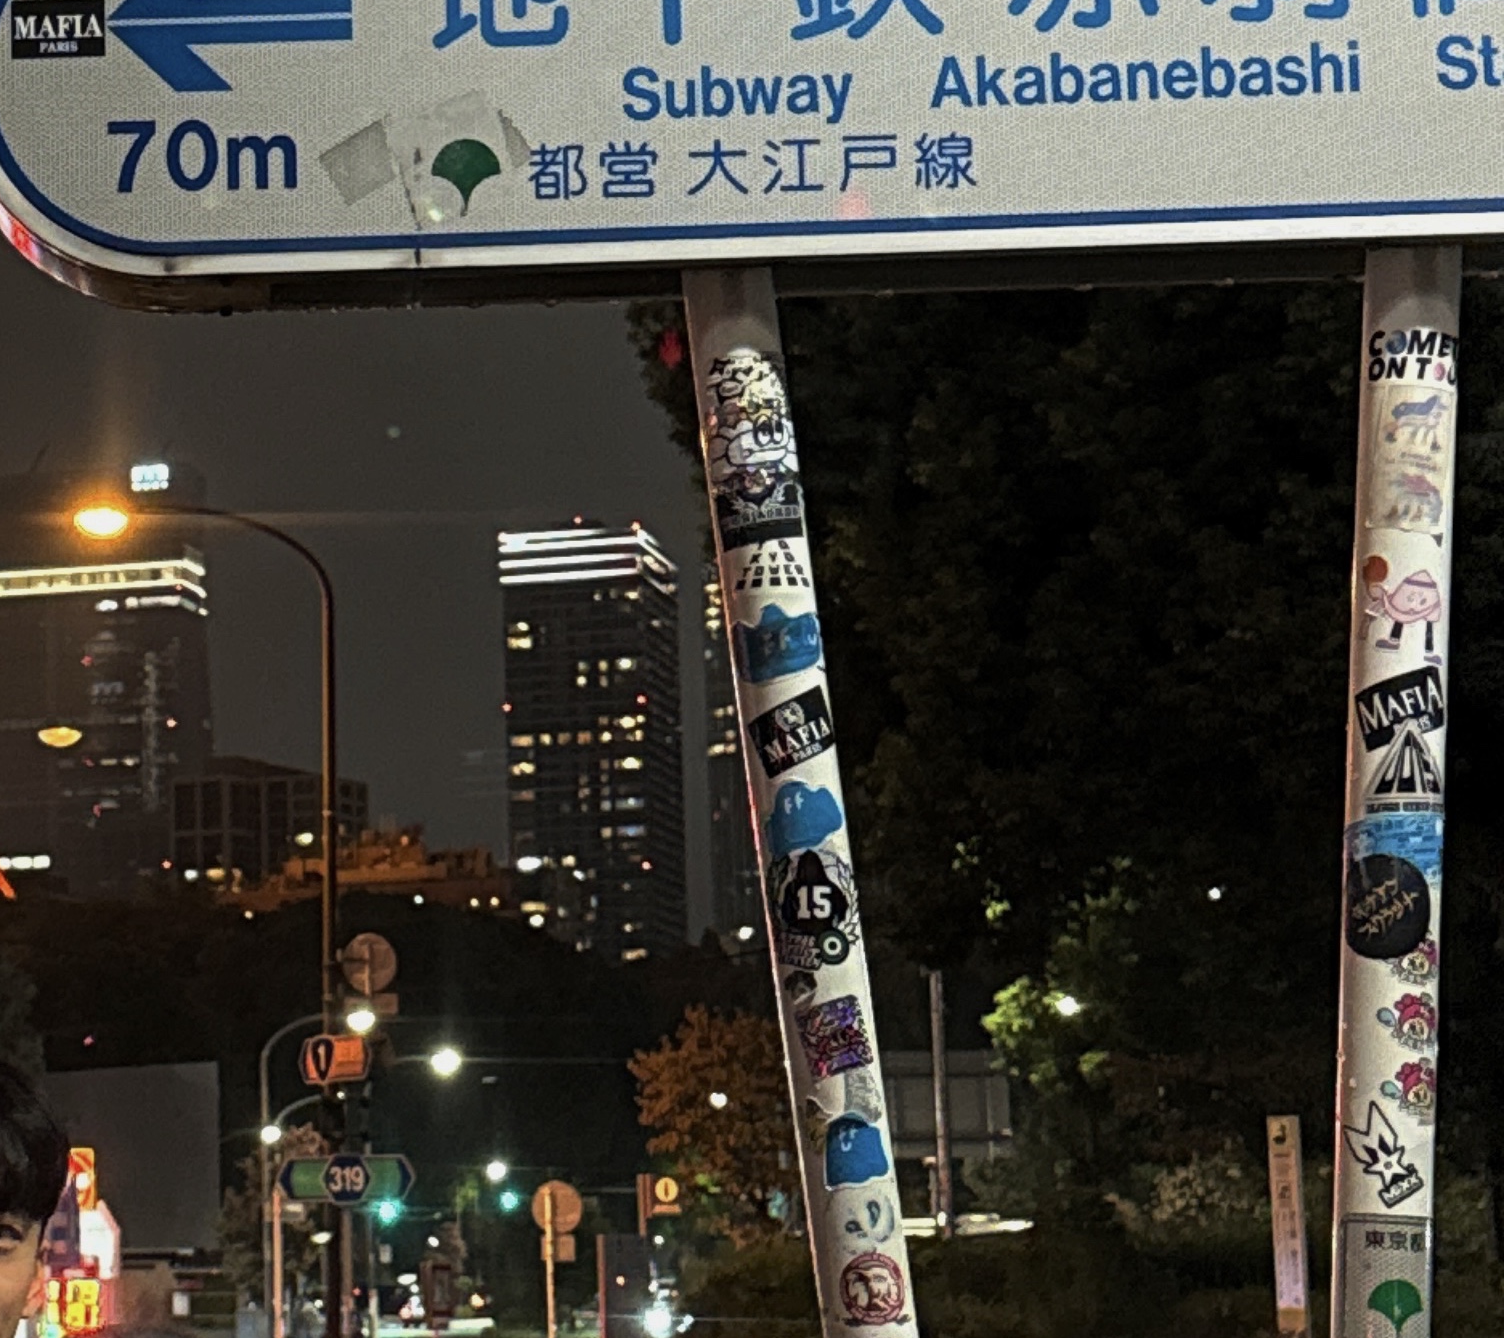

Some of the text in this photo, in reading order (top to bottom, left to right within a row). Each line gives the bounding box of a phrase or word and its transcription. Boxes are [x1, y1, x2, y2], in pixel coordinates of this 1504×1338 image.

[14, 14, 103, 40] MAFIA
[622, 33, 1504, 124] Subway Akabanebashi St
[107, 120, 300, 194] 70m
[528, 130, 978, 200] 都営 大江戸線
[1369, 357, 1408, 381] ON
[1359, 675, 1444, 734] MAFIA
[763, 716, 833, 764] MAFIA
[797, 885, 832, 919] 15
[328, 1165, 366, 1193] 319
